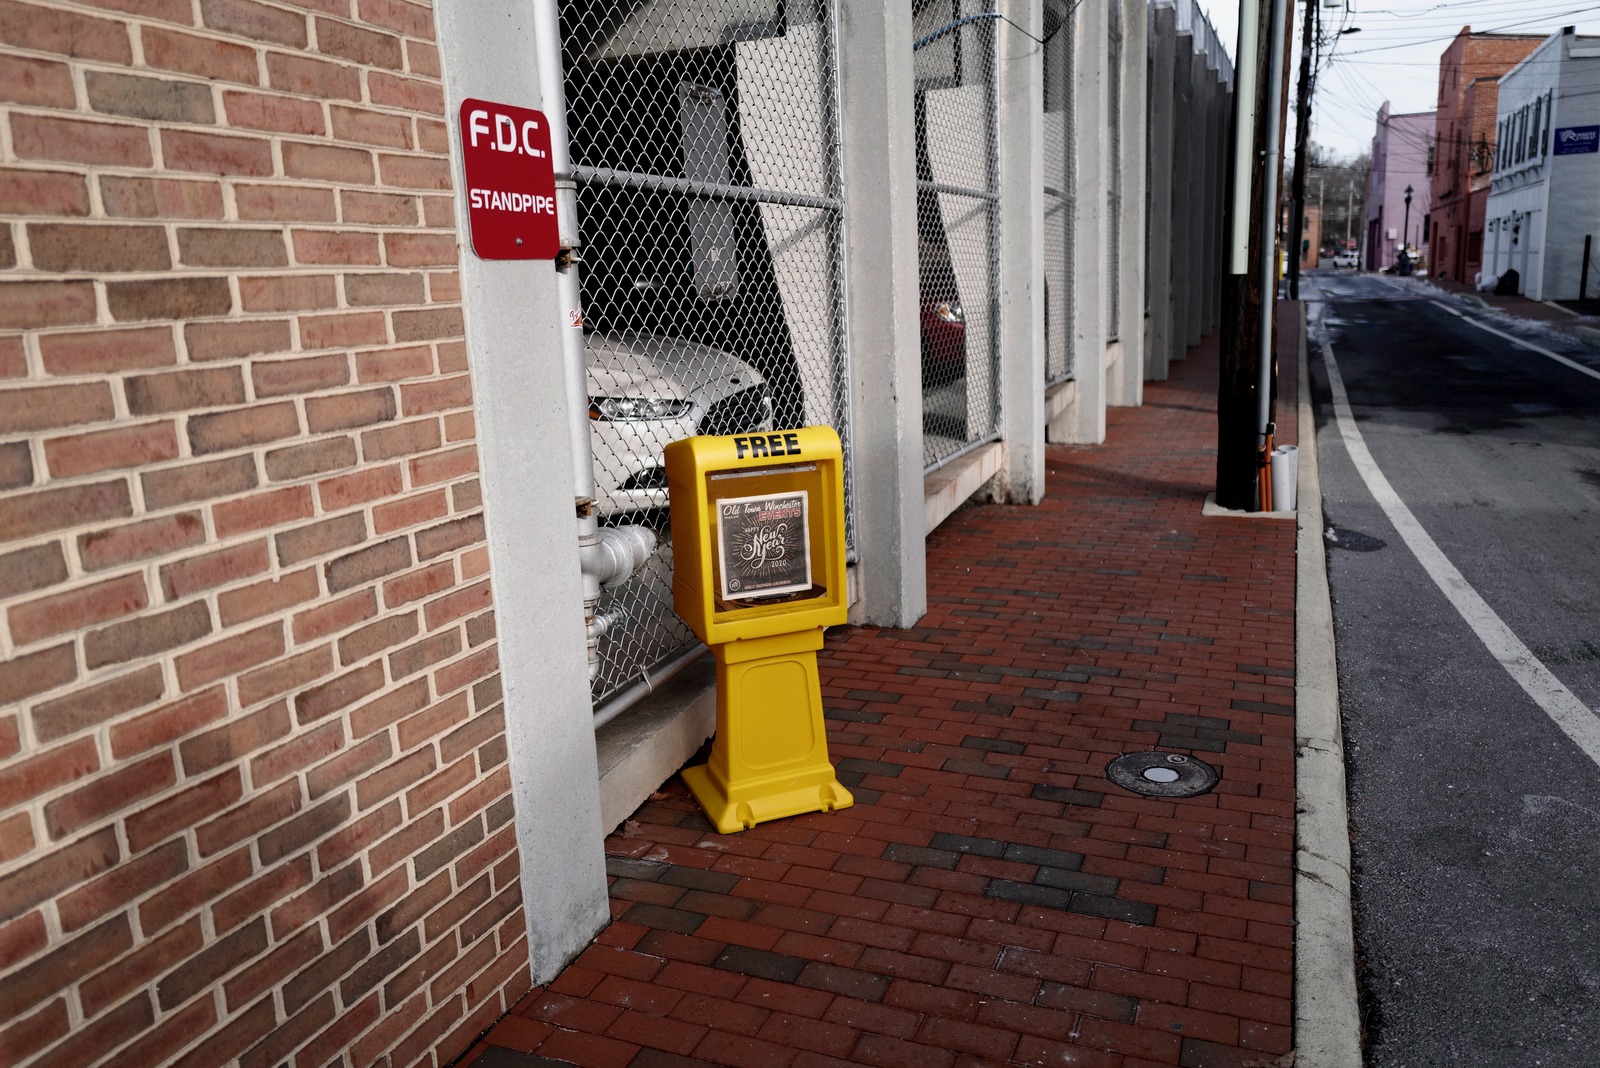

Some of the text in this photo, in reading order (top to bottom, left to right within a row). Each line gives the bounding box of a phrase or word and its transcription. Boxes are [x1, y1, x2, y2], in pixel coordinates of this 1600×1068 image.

[469, 109, 546, 158] F.D.C.
[470, 188, 555, 215] STANDPIPE
[733, 433, 802, 459] FREE
[723, 499, 801, 516] Old Town Winchester
[759, 507, 801, 521] EVENTS
[741, 523, 788, 560] New
[771, 559, 787, 568] 2020
